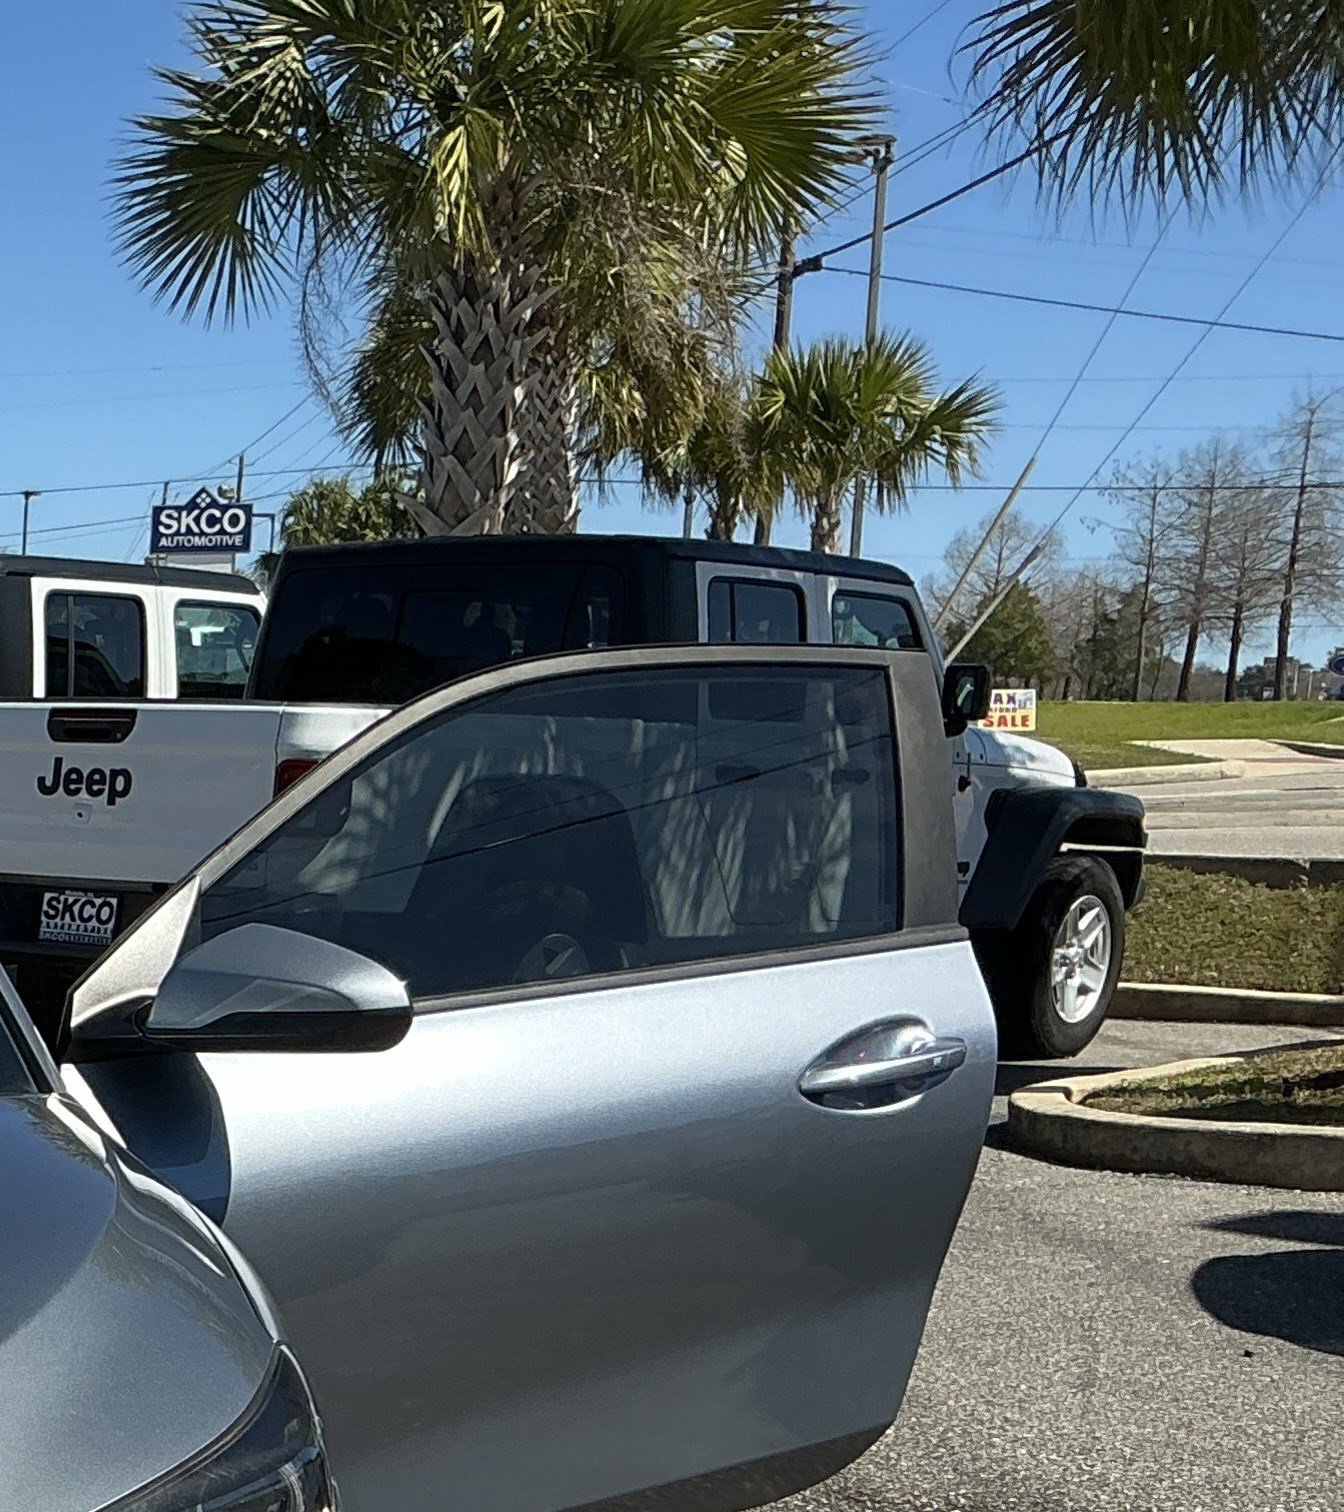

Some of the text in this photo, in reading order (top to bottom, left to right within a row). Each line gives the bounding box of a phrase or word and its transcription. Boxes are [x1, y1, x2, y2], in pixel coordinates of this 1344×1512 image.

[158, 507, 246, 534] SKCO
[158, 535, 244, 547] AUTOMOTIVE
[983, 714, 1030, 727] SALE
[37, 756, 132, 806] Jeep
[43, 896, 115, 926] SKCO
